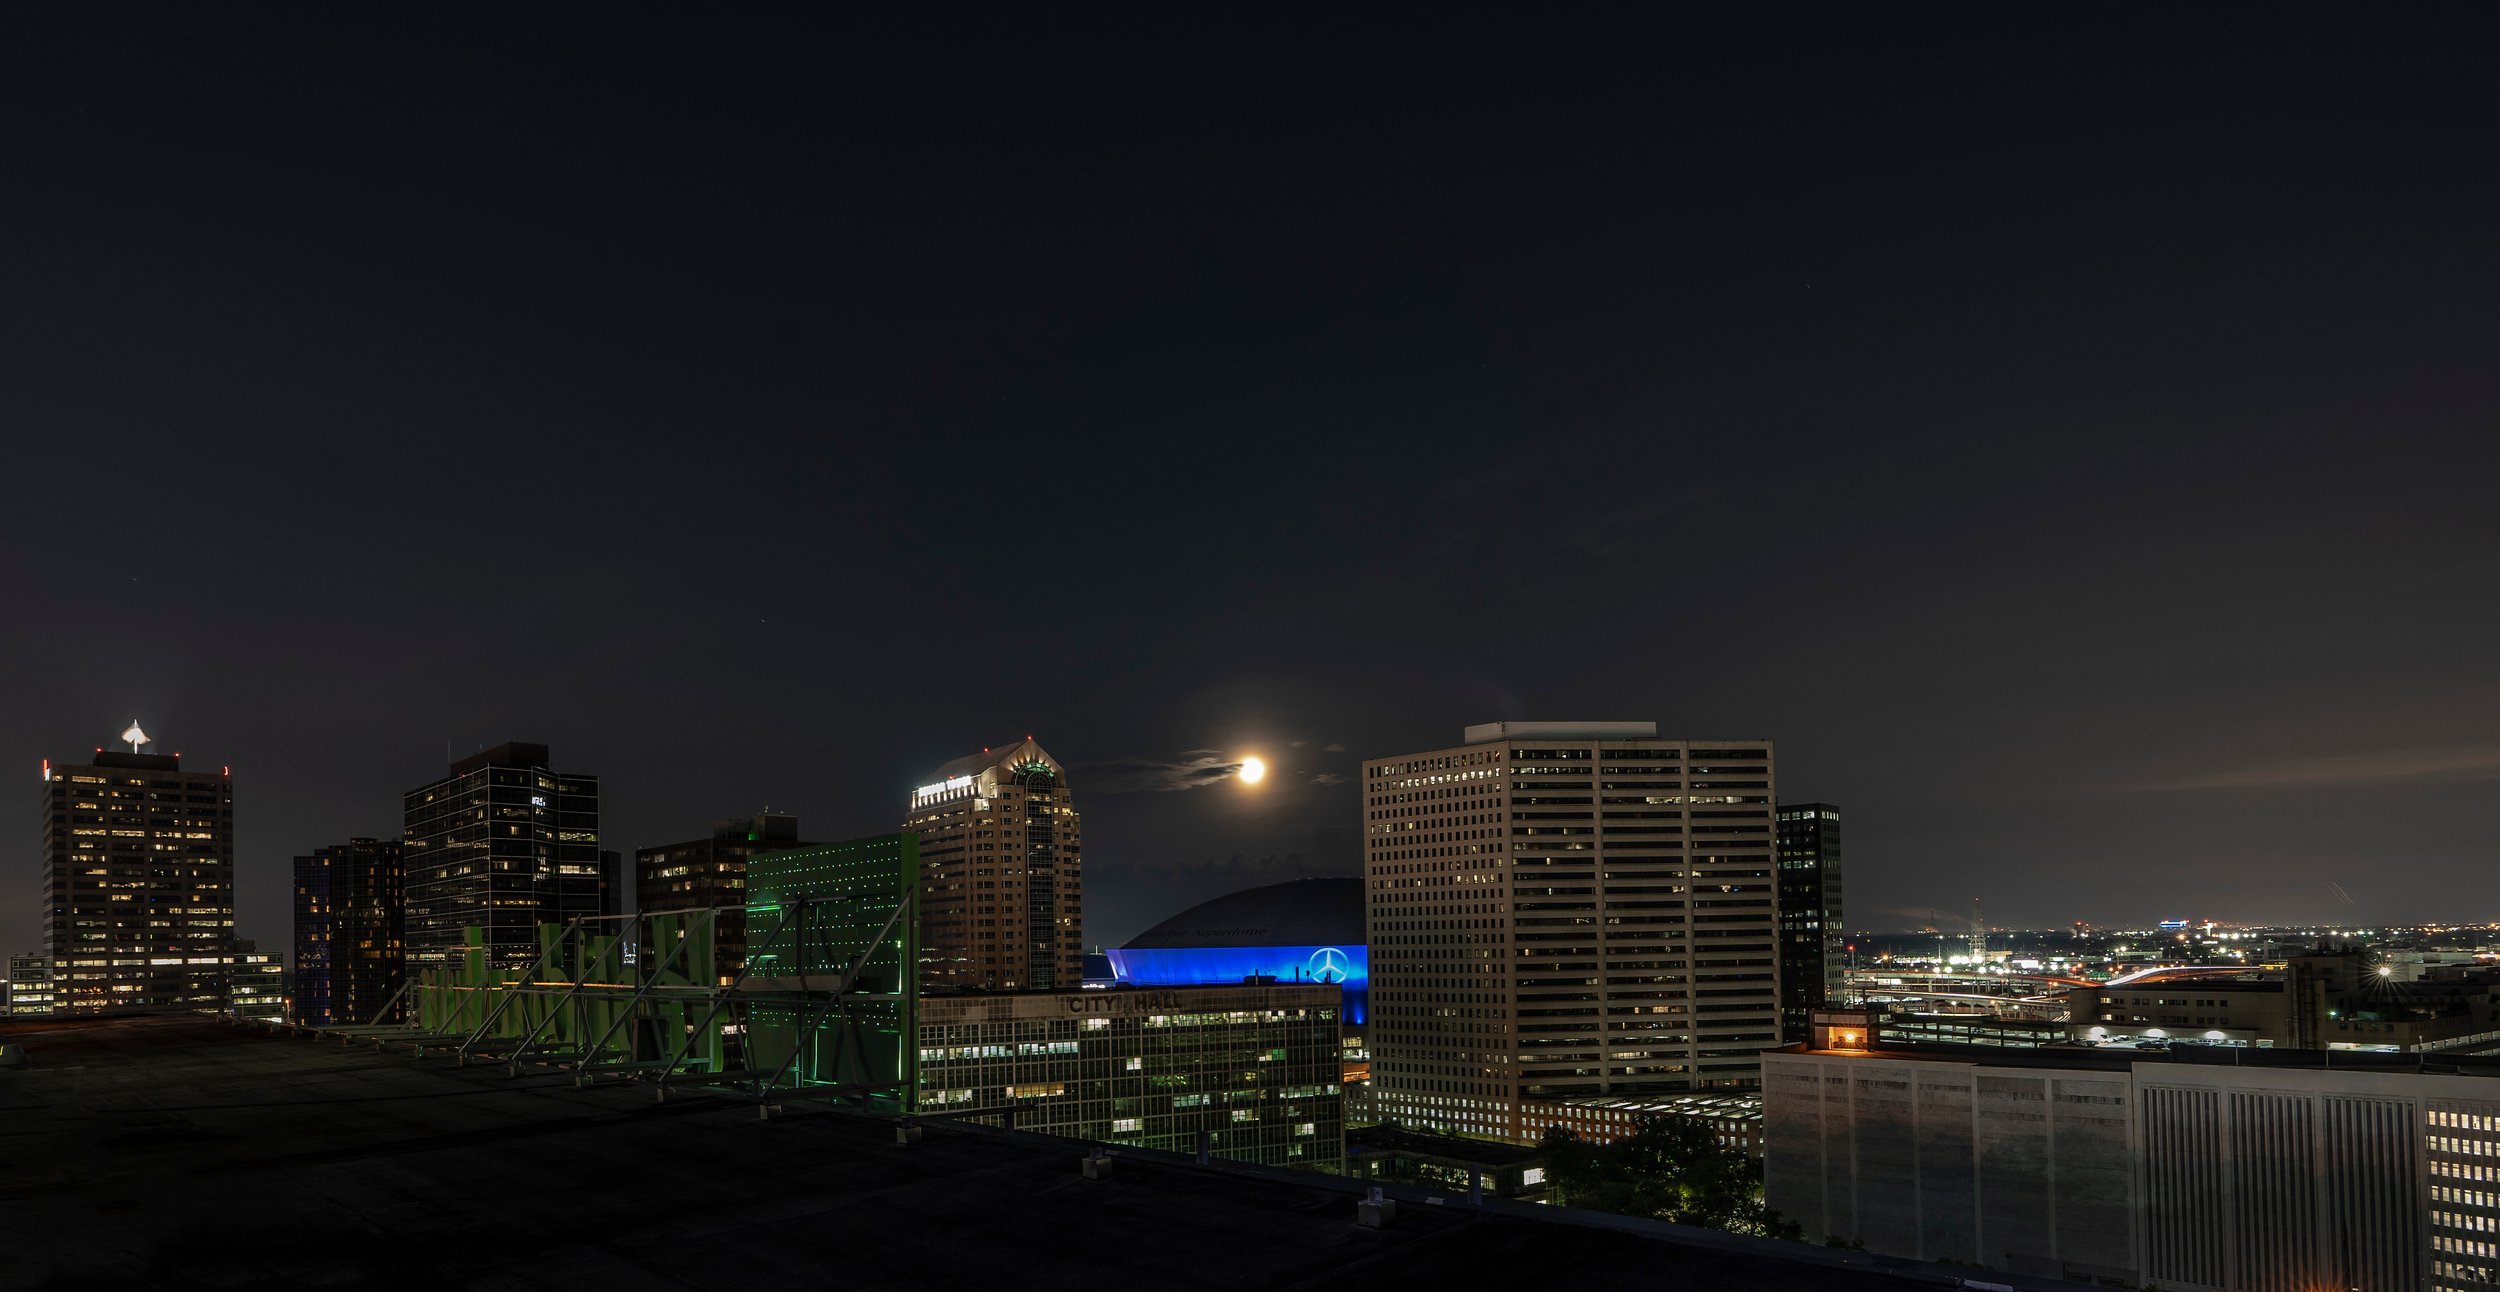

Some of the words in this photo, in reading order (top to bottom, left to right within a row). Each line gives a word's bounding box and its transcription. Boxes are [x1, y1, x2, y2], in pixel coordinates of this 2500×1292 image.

[1194, 926, 1269, 939] Superdome
[1069, 997, 1115, 1013] CITY
[1134, 990, 1182, 1009] HALL
